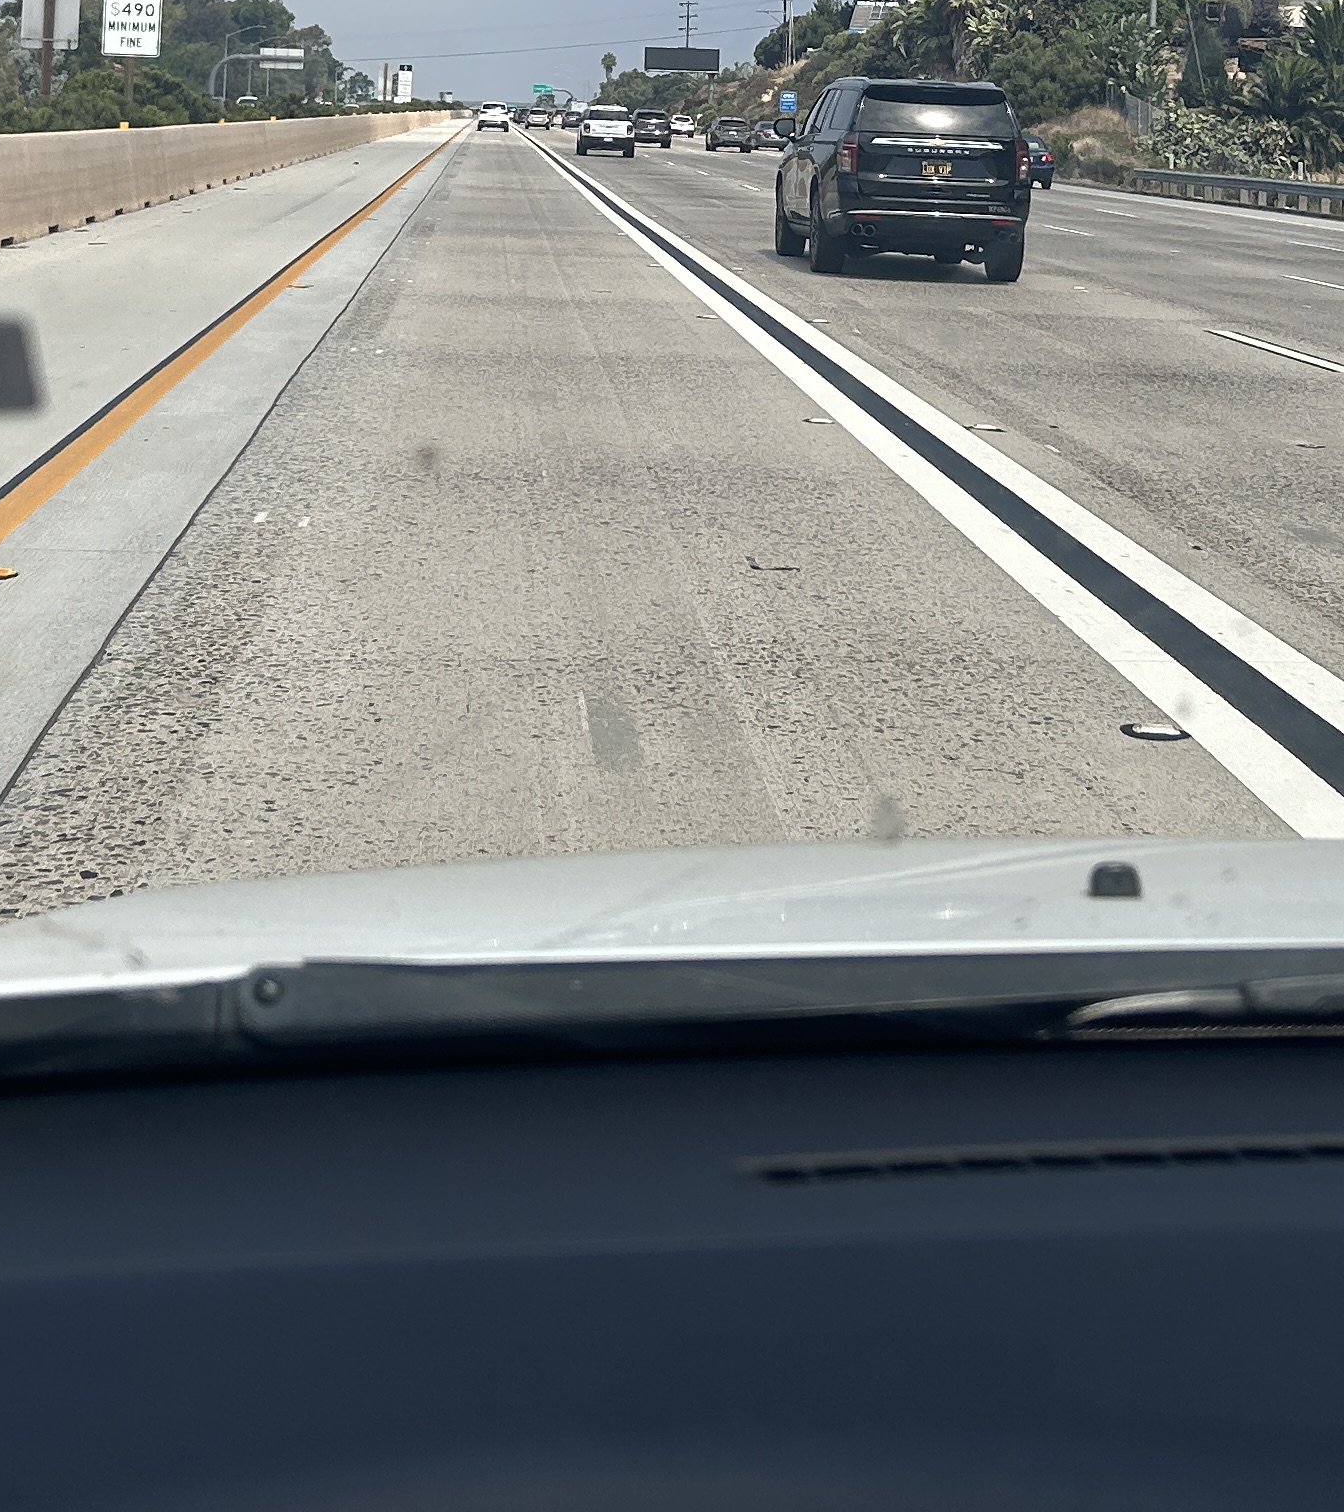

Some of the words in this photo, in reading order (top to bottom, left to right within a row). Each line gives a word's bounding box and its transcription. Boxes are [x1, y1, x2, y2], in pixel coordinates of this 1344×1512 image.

[110, 1, 155, 17] $490
[108, 20, 156, 33] MINIMUM
[120, 36, 143, 48] FINE
